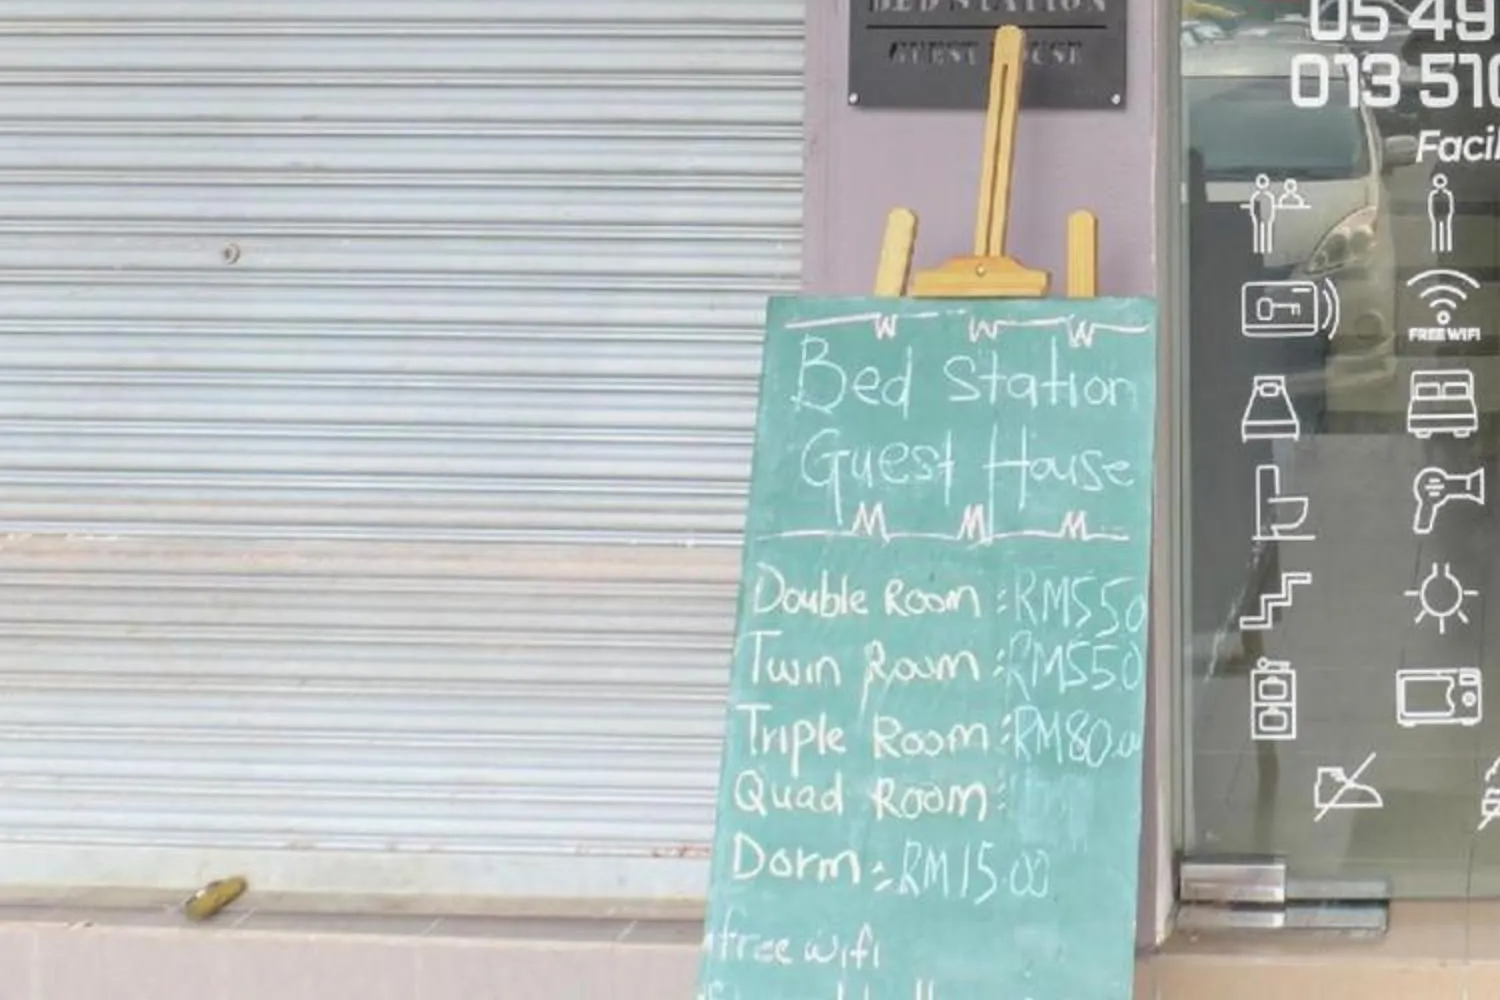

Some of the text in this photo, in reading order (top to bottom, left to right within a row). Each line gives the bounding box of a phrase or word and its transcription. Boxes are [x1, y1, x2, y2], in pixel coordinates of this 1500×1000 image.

[1289, 55, 1401, 109] 013
[1408, 326, 1481, 342] FREE WIFI
[792, 332, 1138, 420] Bed Station
[799, 424, 1135, 540] Guest House
[753, 562, 869, 618] Double
[884, 578, 982, 618] Room
[744, 630, 841, 687] Twin
[862, 640, 980, 704] Room
[736, 704, 847, 778] Triple
[873, 715, 989, 760] Room
[734, 770, 844, 816] Quad
